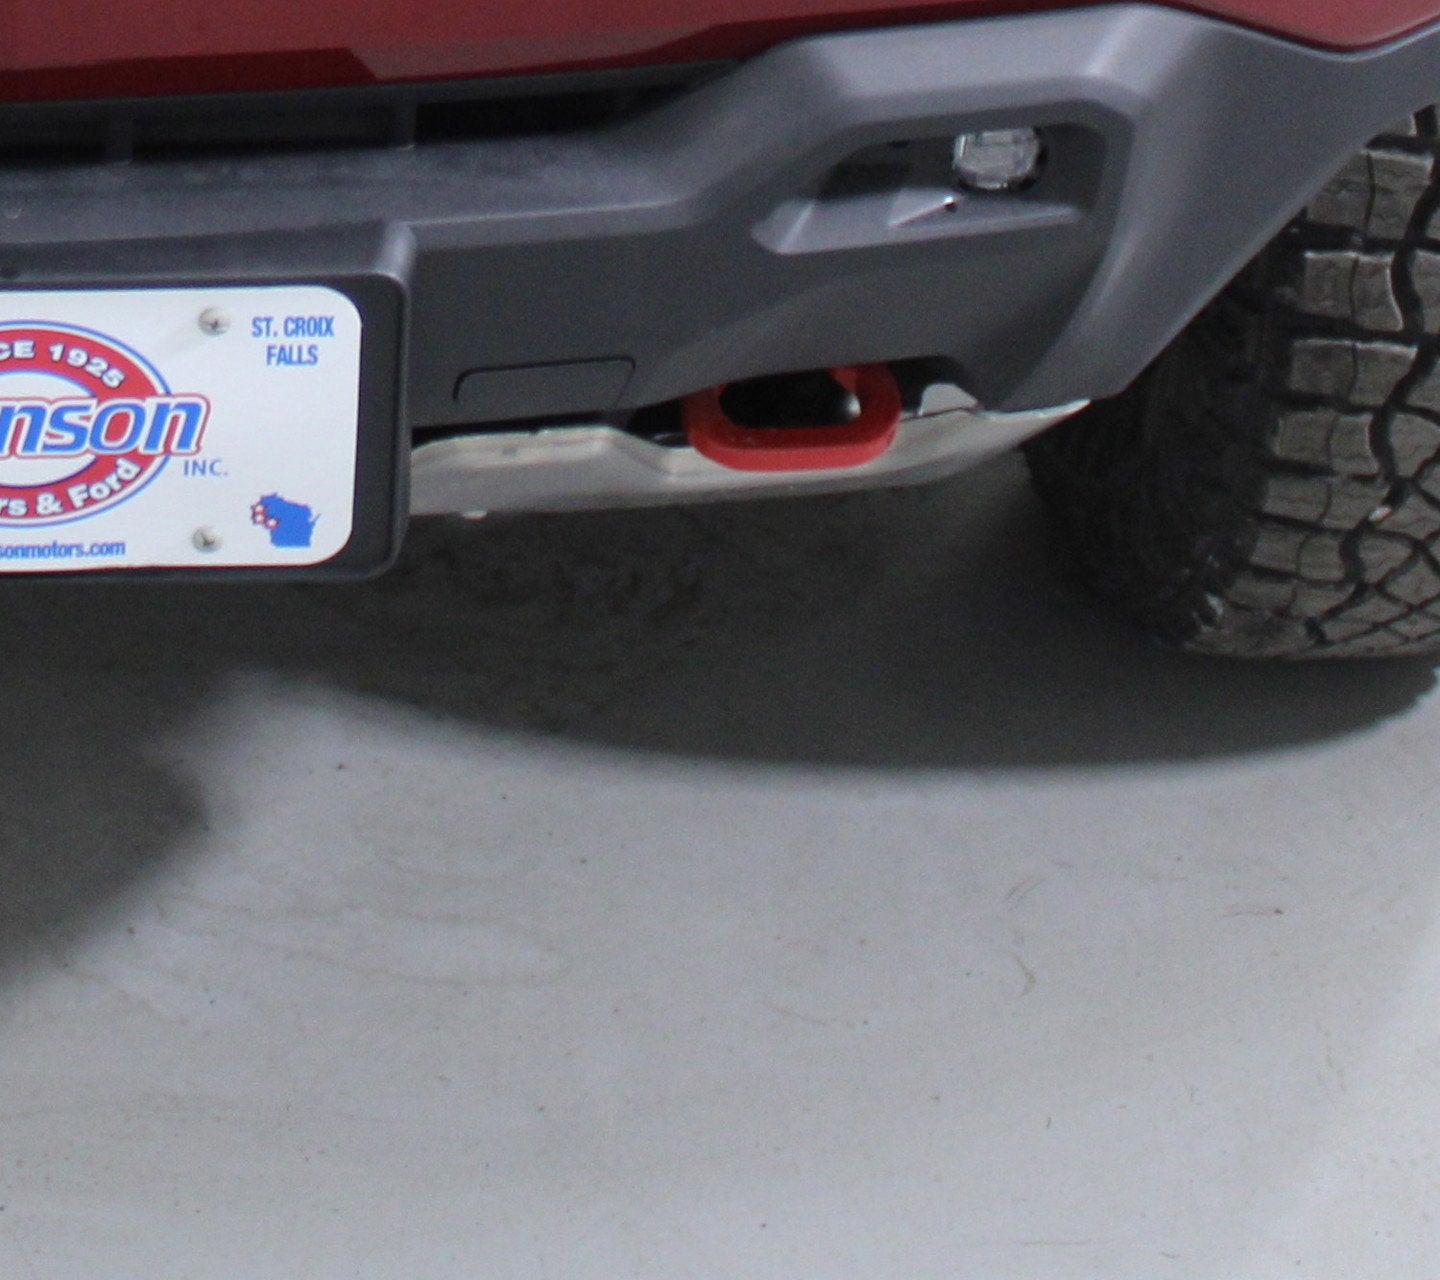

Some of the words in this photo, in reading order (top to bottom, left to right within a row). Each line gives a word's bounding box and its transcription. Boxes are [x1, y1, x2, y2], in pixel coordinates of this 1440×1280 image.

[252, 316, 278, 337] ST.
[283, 316, 335, 337] CROIX
[267, 344, 319, 365] FALLS
[49, 342, 126, 389] 1925
[183, 459, 229, 477] INC.
[35, 491, 62, 516] &
[67, 456, 142, 509] Ford
